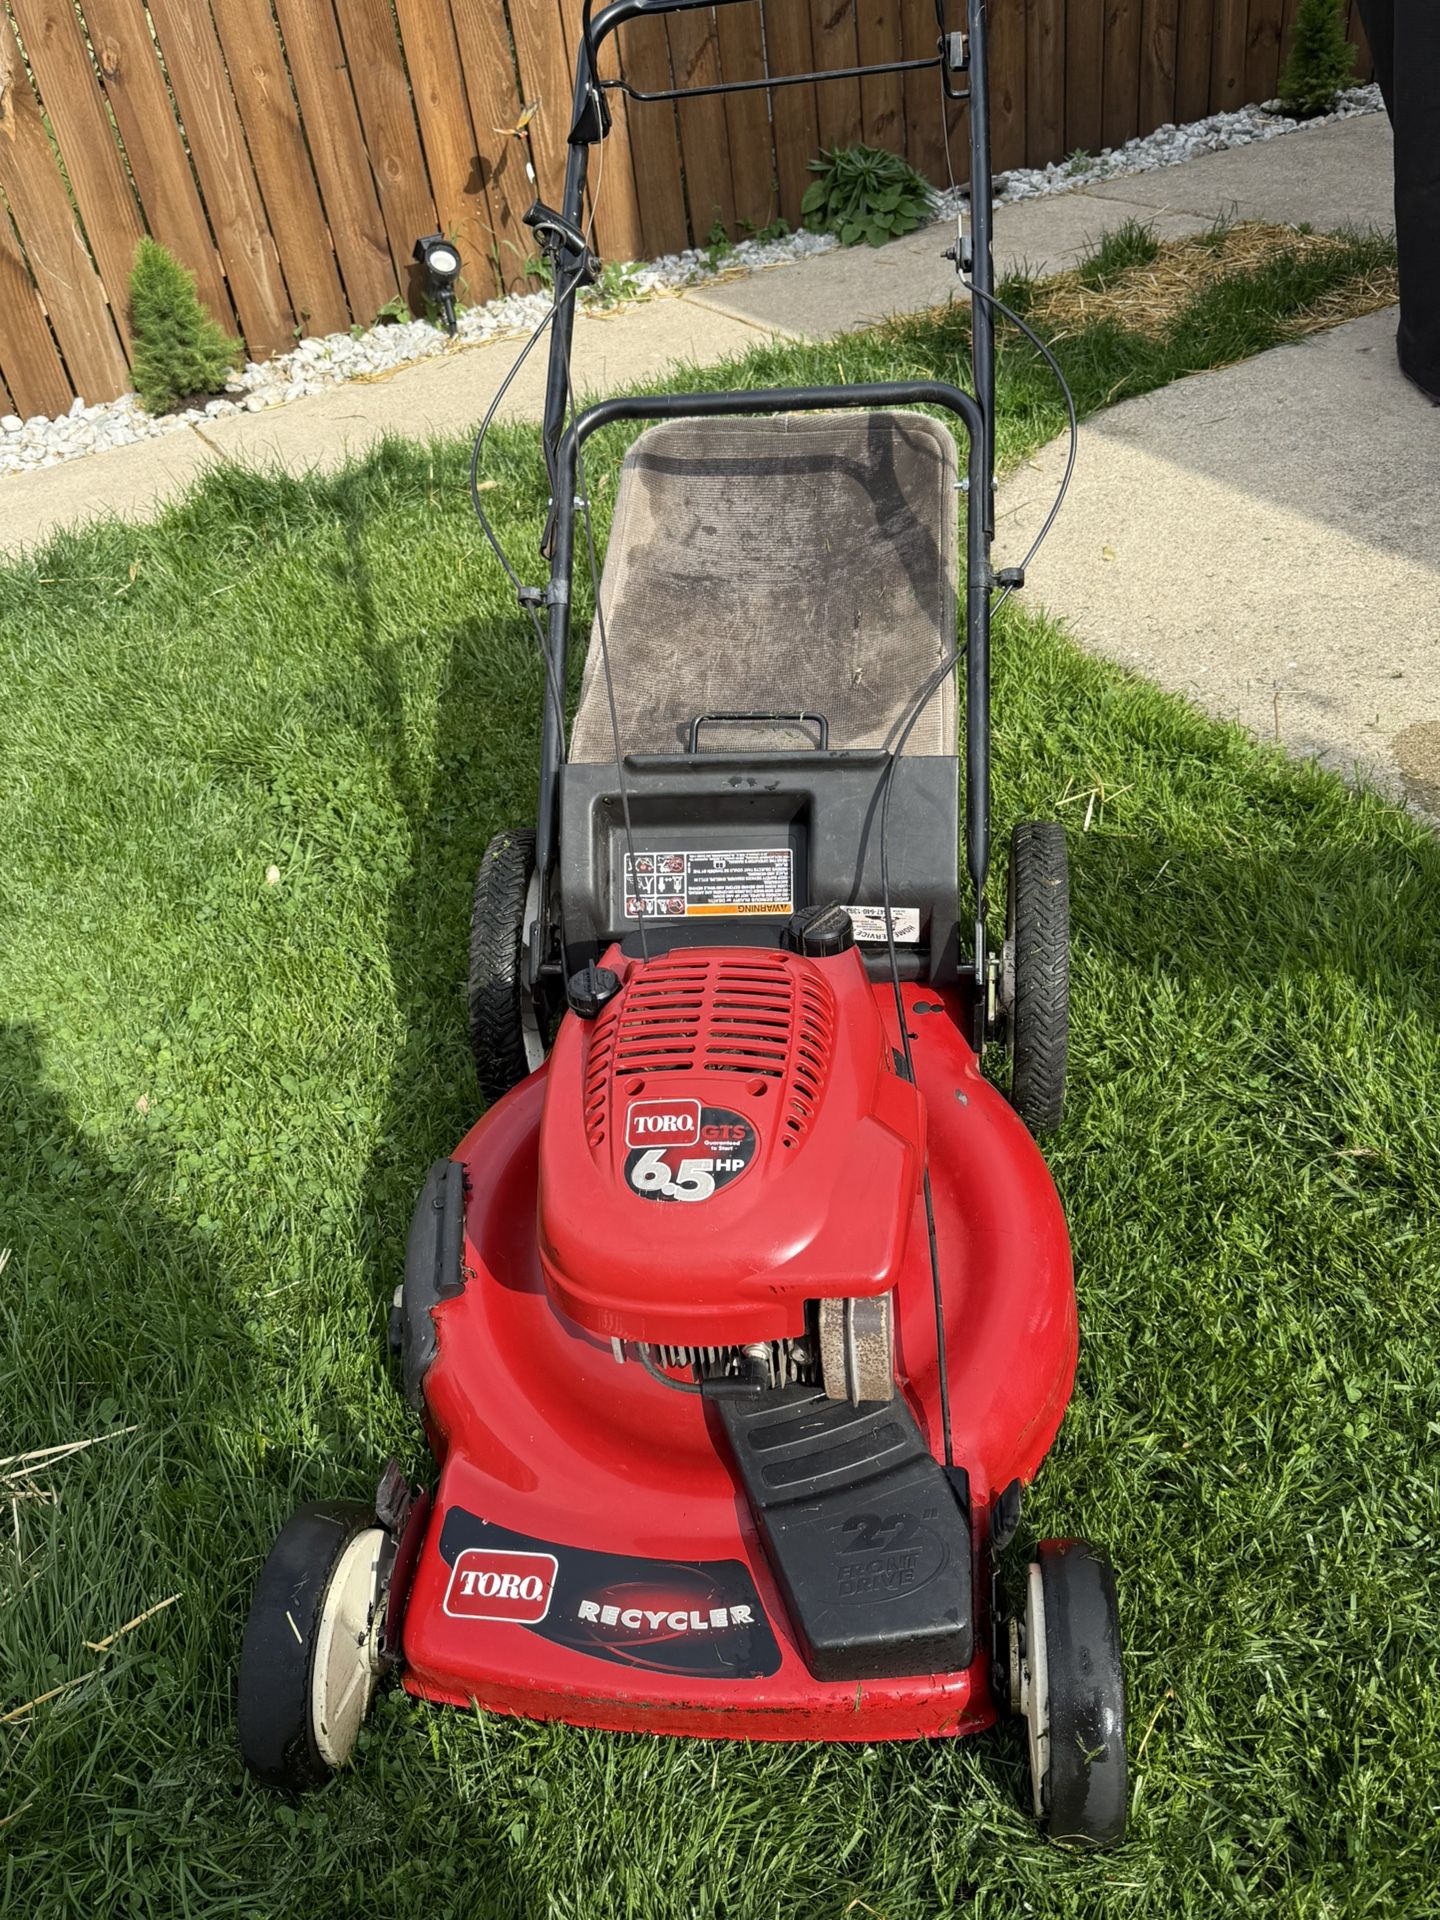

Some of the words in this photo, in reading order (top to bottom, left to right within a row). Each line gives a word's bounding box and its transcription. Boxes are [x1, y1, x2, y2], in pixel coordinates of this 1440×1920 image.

[856, 930, 887, 940] ERVICE
[894, 924, 915, 938] HOME
[701, 1124, 746, 1139] GTS
[703, 1139, 741, 1147] Guaranteed
[631, 1149, 716, 1202] 6.5
[716, 1159, 745, 1172] HP
[837, 1554, 920, 1582] FRONT
[838, 1569, 915, 1598] DRIVE
[577, 1600, 755, 1630] RECYCLER
